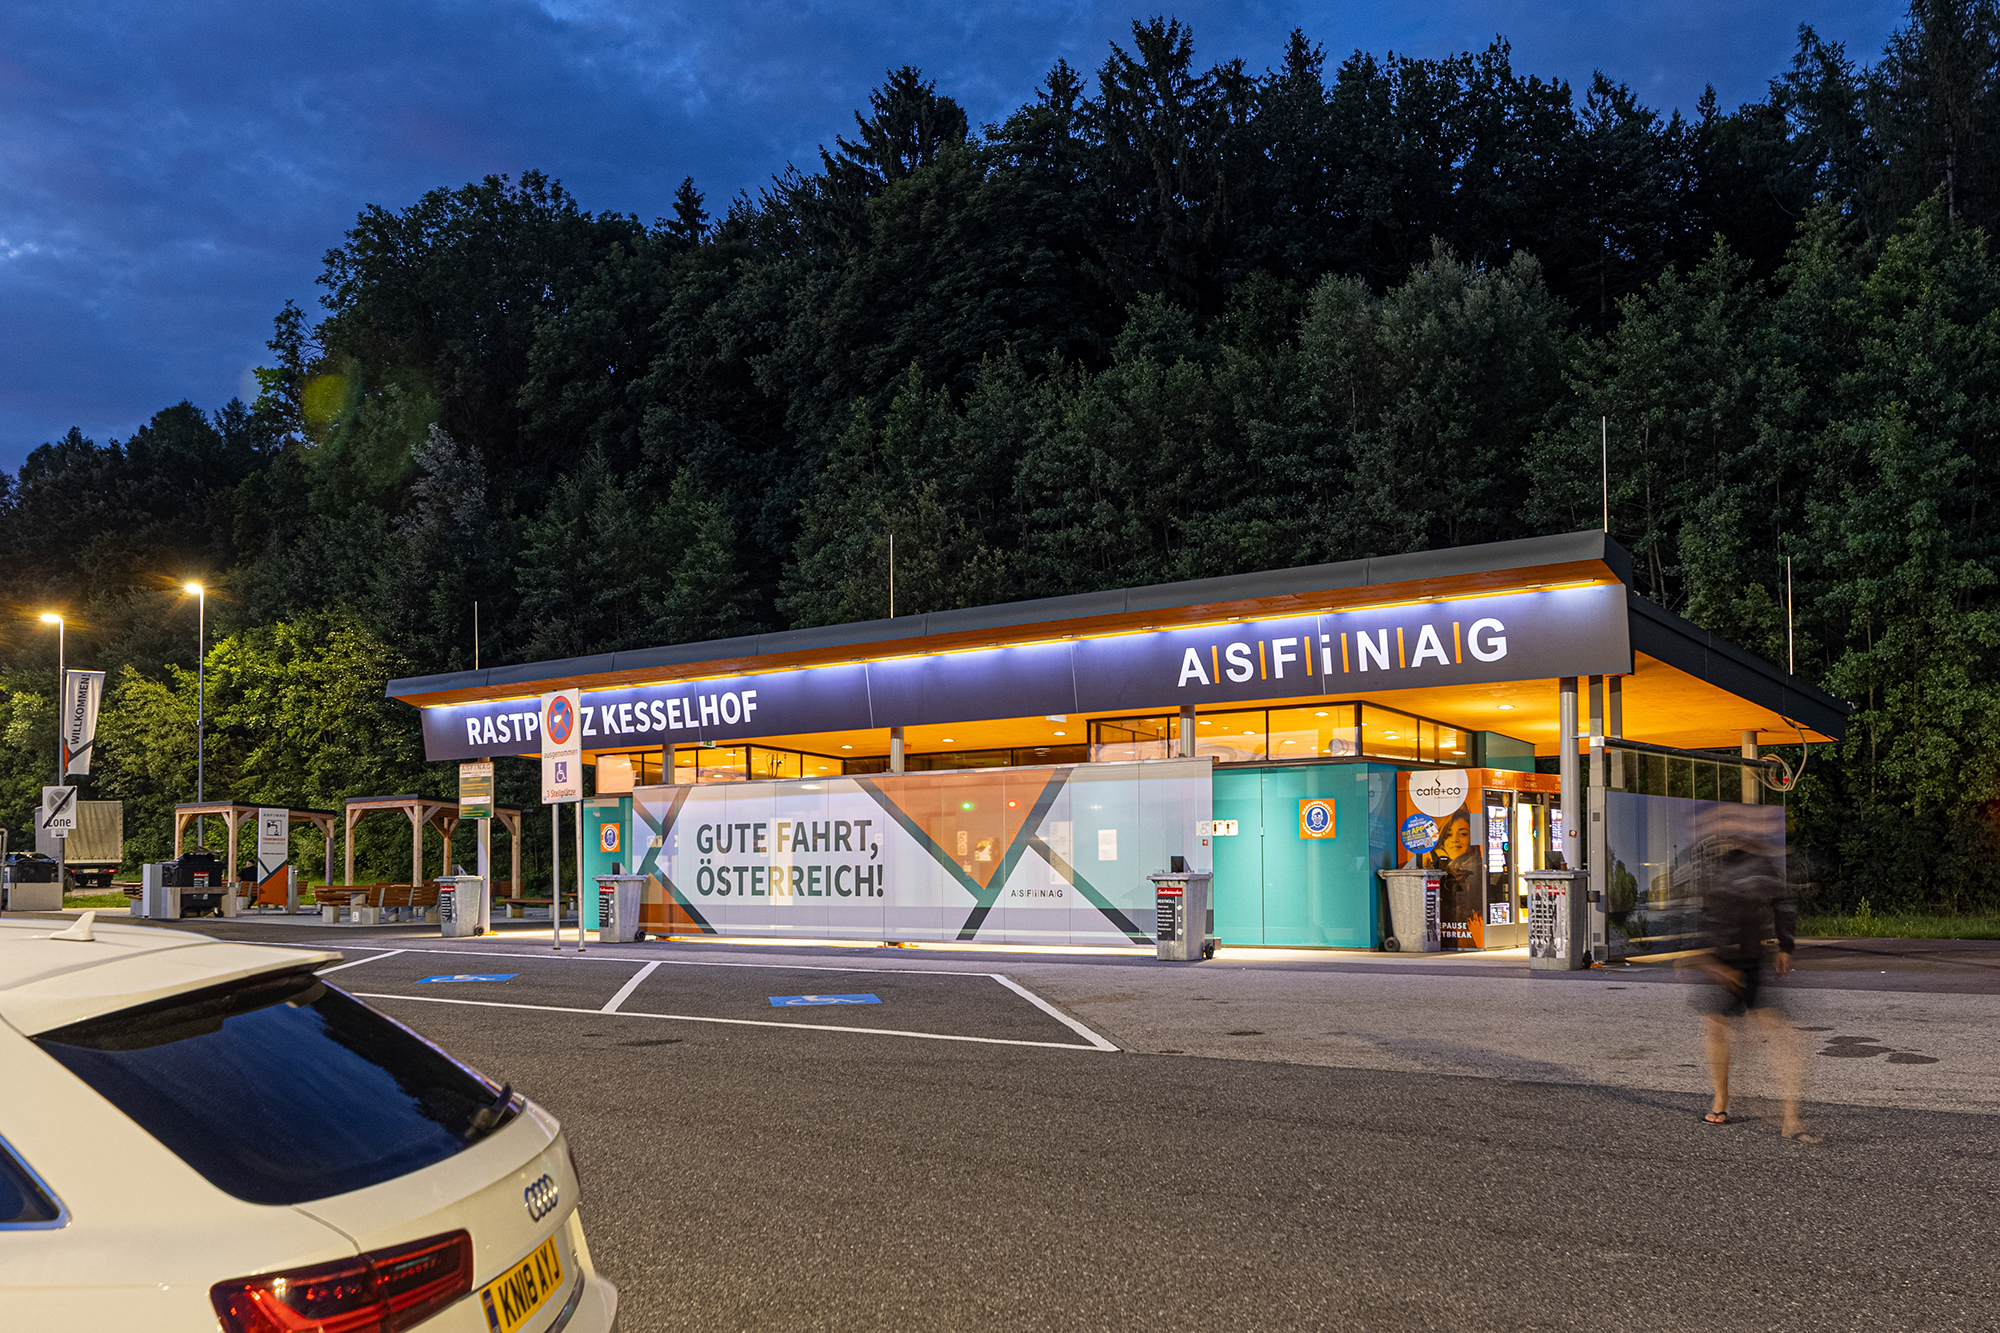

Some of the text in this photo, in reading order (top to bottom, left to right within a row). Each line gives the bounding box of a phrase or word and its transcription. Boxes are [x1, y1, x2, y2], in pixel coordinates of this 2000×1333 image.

[71, 674, 91, 745] WILLKOMMEN!
[465, 689, 758, 746] RASTPZ KESSELHOF
[543, 749, 578, 760] ausgenommen
[546, 787, 577, 798] 3 Stellplätze
[696, 819, 879, 861] GUTE FAHRT,
[696, 858, 884, 898] ÖSTERREICH!
[498, 1239, 560, 1329] KN18 AYJ
